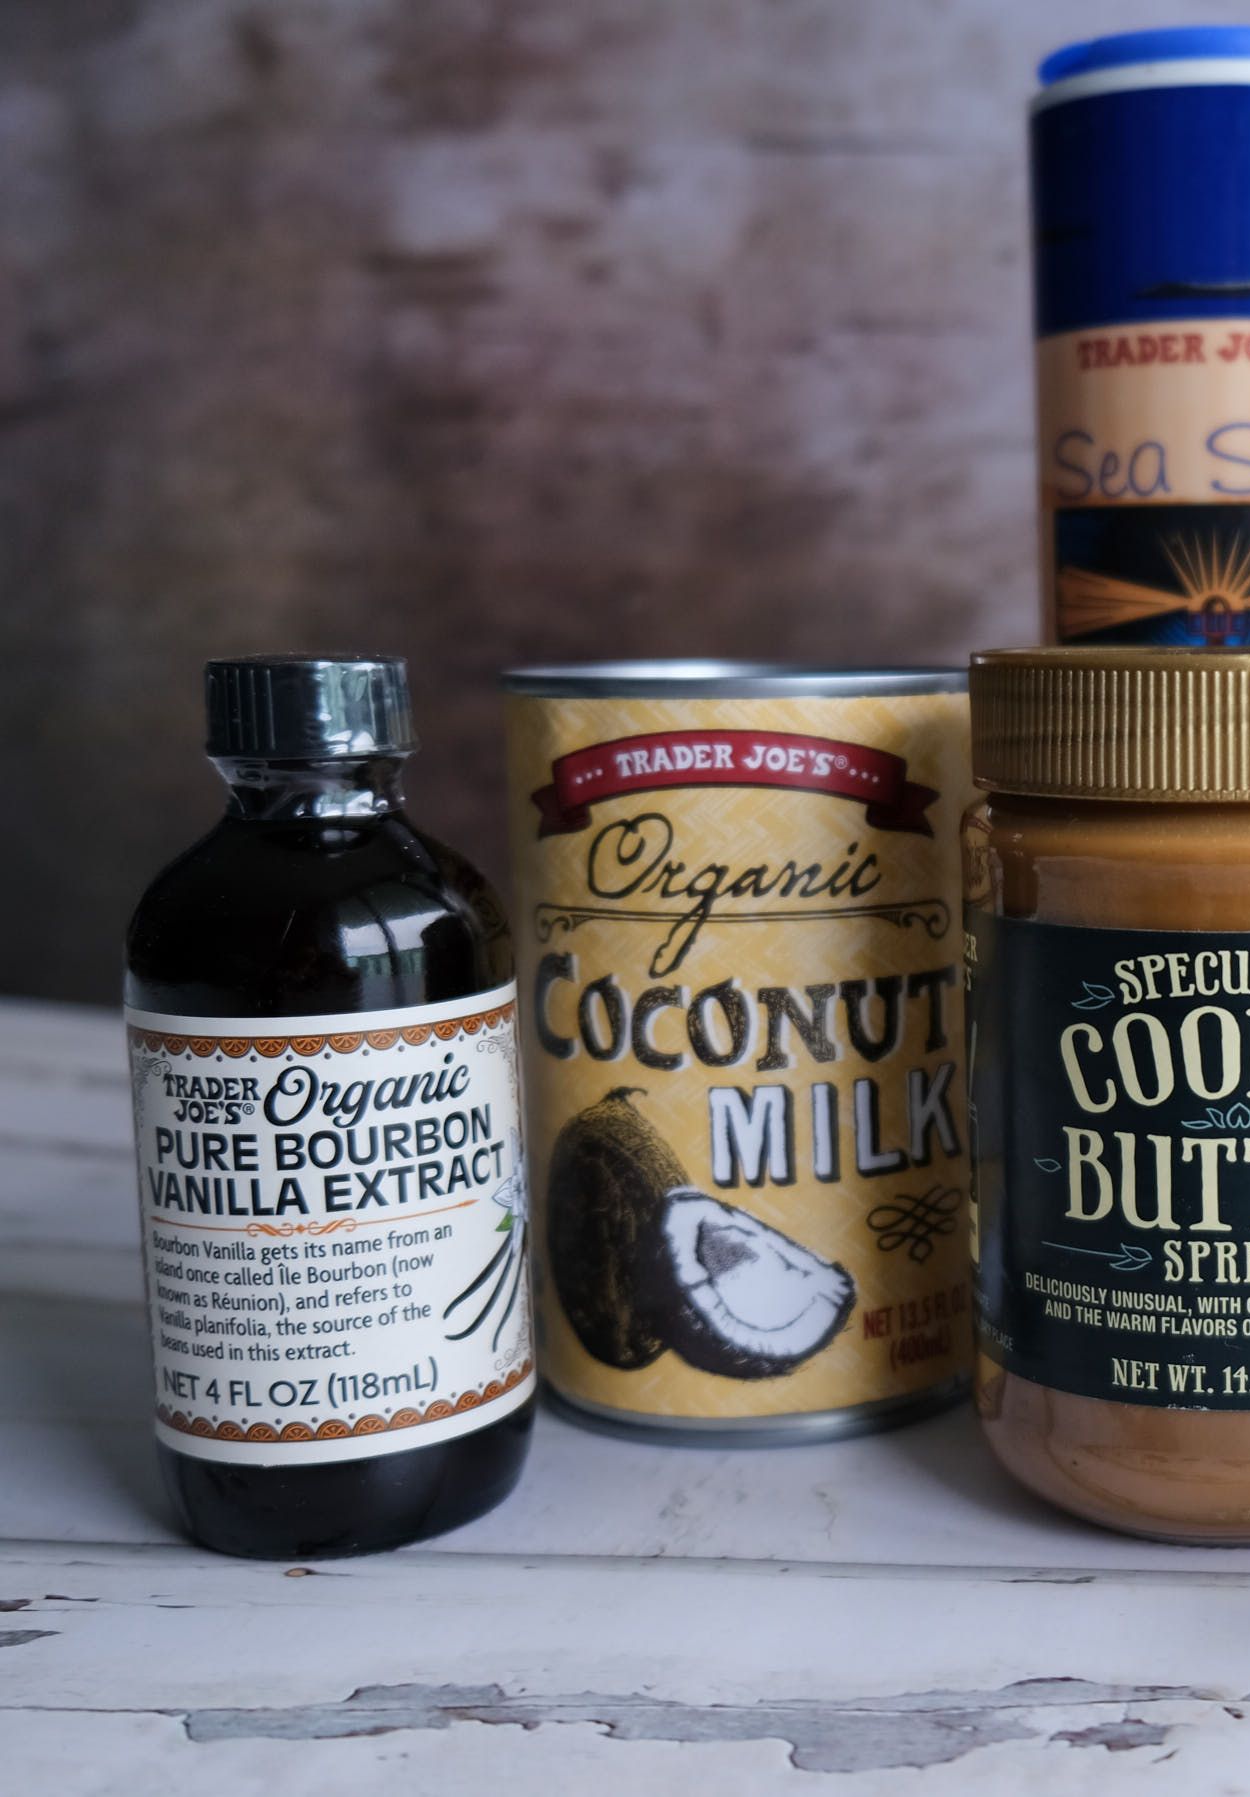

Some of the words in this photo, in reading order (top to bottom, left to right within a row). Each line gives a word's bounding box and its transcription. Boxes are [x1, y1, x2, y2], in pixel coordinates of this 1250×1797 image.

[1076, 333, 1206, 371] TRADER
[1054, 430, 1171, 498] Sea
[615, 744, 734, 778] TRADER
[587, 812, 882, 978] Organic
[535, 951, 957, 1071] COCONUT
[163, 1072, 261, 1100] TRADER
[264, 1051, 470, 1128] Organic
[155, 1126, 259, 1172] PURE
[275, 1103, 492, 1171] BOURBON
[708, 1062, 962, 1188] MILK
[148, 1166, 310, 1216] VANILLA
[324, 1141, 506, 1213] EXTRACT
[153, 1230, 199, 1257] Bourbon
[203, 1240, 256, 1260] Vanilla
[261, 1244, 298, 1265] gets
[304, 1242, 326, 1259] its
[332, 1238, 382, 1257] name
[387, 1230, 429, 1249] from
[434, 1224, 452, 1240] an
[155, 1256, 183, 1280] island
[186, 1268, 219, 1284] once
[224, 1267, 273, 1285] called
[278, 1263, 301, 1285] Île
[307, 1261, 387, 1284] Bourbon
[392, 1253, 434, 1278] (now
[157, 1279, 190, 1305] known
[194, 1293, 207, 1308] as
[212, 1291, 290, 1315] Réunion),
[296, 1290, 329, 1310] and
[335, 1286, 388, 1306] refers
[393, 1283, 412, 1297] to
[1025, 1272, 1107, 1305] DELICIOUSLY
[1112, 1290, 1192, 1316] UNUSUAL,
[1197, 1297, 1241, 1314] WITH
[159, 1306, 191, 1331] Vanilla
[195, 1315, 271, 1338] planifolia,
[276, 1317, 307, 1336] the
[313, 1315, 372, 1334] source
[378, 1306, 398, 1326] of
[402, 1302, 431, 1321] the
[863, 1305, 893, 1340] NET
[1045, 1300, 1071, 1320] AND
[1075, 1306, 1102, 1326] THE
[1107, 1311, 1156, 1333] WARM
[1161, 1317, 1237, 1337] FLAVORS
[160, 1328, 189, 1355] beans
[192, 1341, 224, 1360] used
[229, 1344, 243, 1361] in
[248, 1343, 280, 1361] this
[285, 1340, 355, 1360] extract.
[163, 1366, 200, 1400] NET
[205, 1379, 221, 1405] 4
[229, 1380, 262, 1406] FL
[269, 1379, 320, 1407] OZ
[328, 1356, 438, 1408] (118mL)
[1111, 1358, 1160, 1391] NET
[1168, 1364, 1214, 1394] WT.
